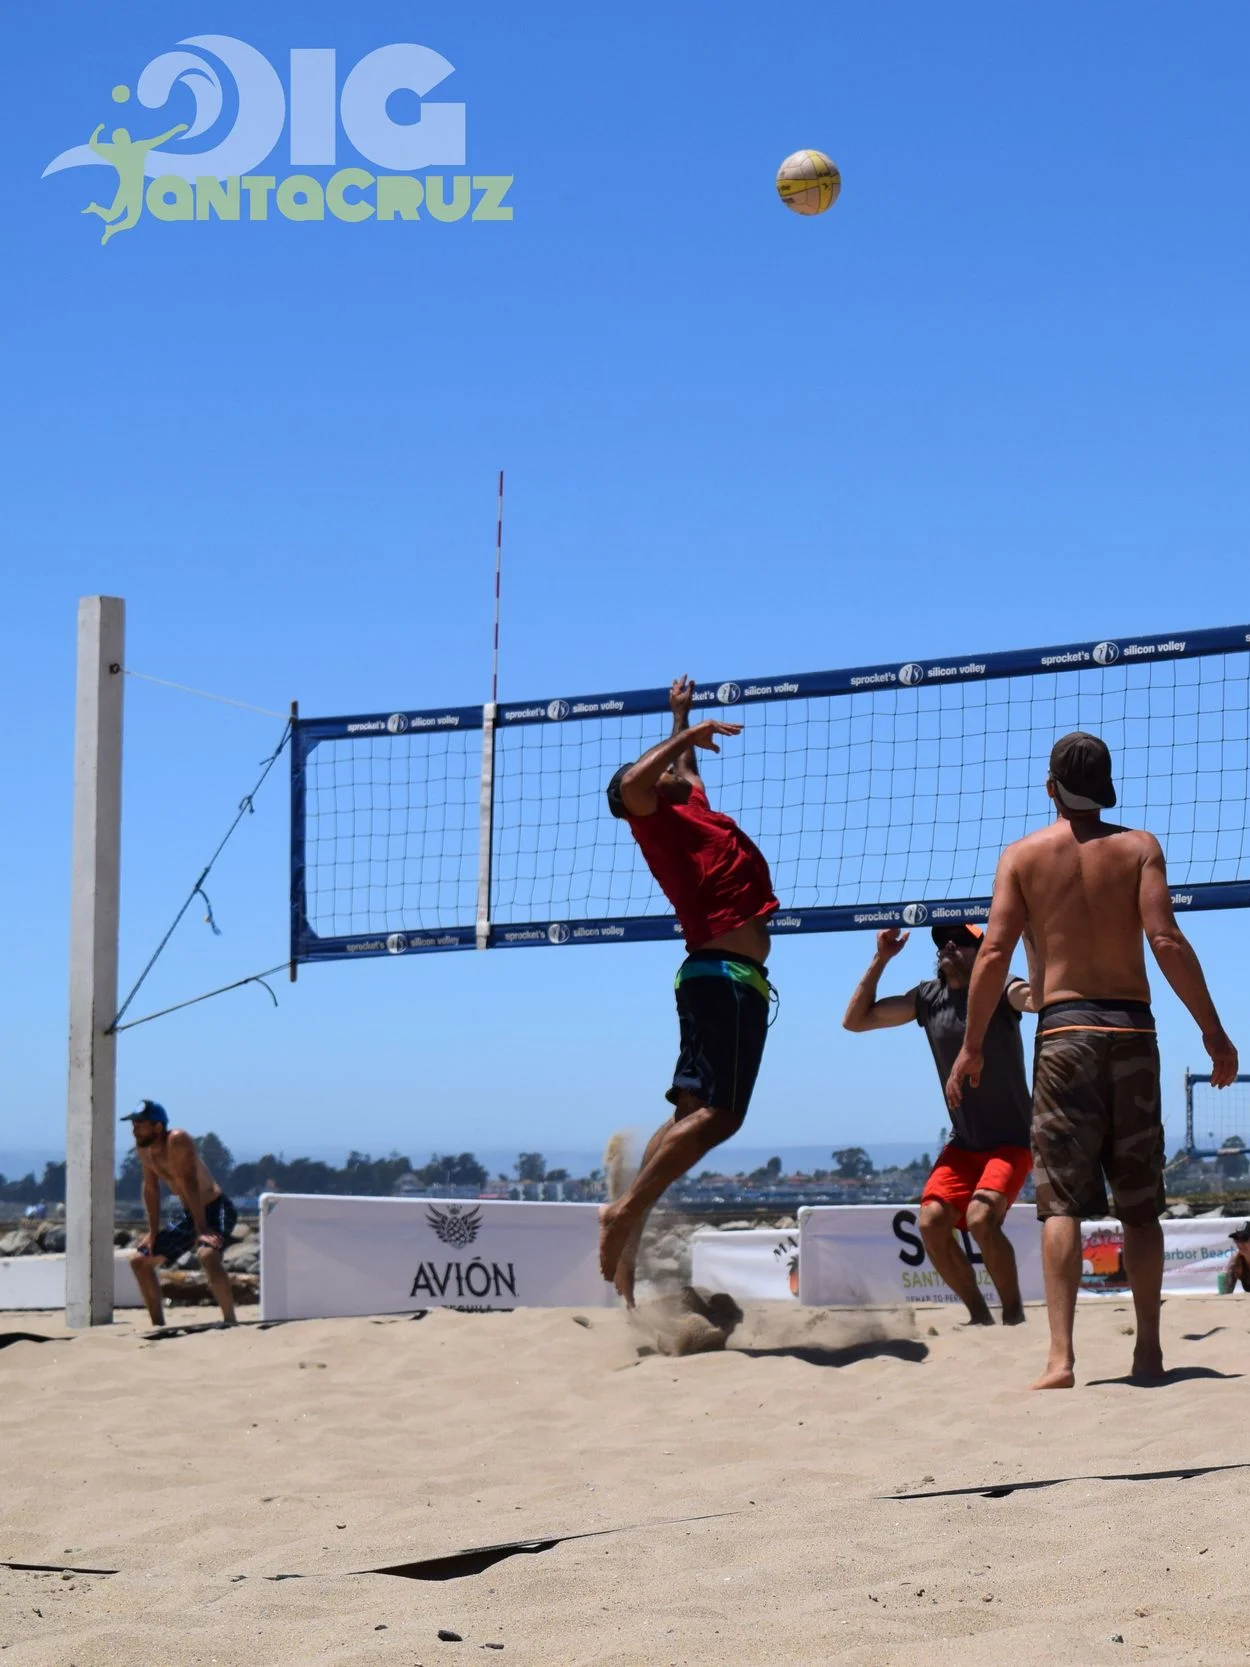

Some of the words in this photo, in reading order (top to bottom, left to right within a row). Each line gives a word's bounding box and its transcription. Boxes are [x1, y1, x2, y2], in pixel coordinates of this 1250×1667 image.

[1041, 651, 1089, 666] sprocket's
[1124, 645, 1155, 656] silicon
[1157, 641, 1185, 654] volley
[851, 672, 896, 686] sprocket's
[928, 667, 957, 677] silicon
[959, 663, 985, 676] volley
[692, 691, 715, 701] cket's
[744, 686, 772, 696] silicon
[774, 683, 798, 693] volley
[505, 707, 545, 720] sprocket's
[573, 703, 598, 713] silicon
[600, 700, 624, 712] volley
[347, 721, 385, 732] sprocket's
[411, 717, 436, 727] silicon
[437, 716, 459, 725] volley
[1171, 892, 1192, 904] olley
[775, 916, 801, 927] volley
[854, 911, 900, 923] sprocket's
[932, 908, 961, 918] silicon
[1163, 1248, 1197, 1260] arbor
[410, 1256, 516, 1297] AVIÓN
